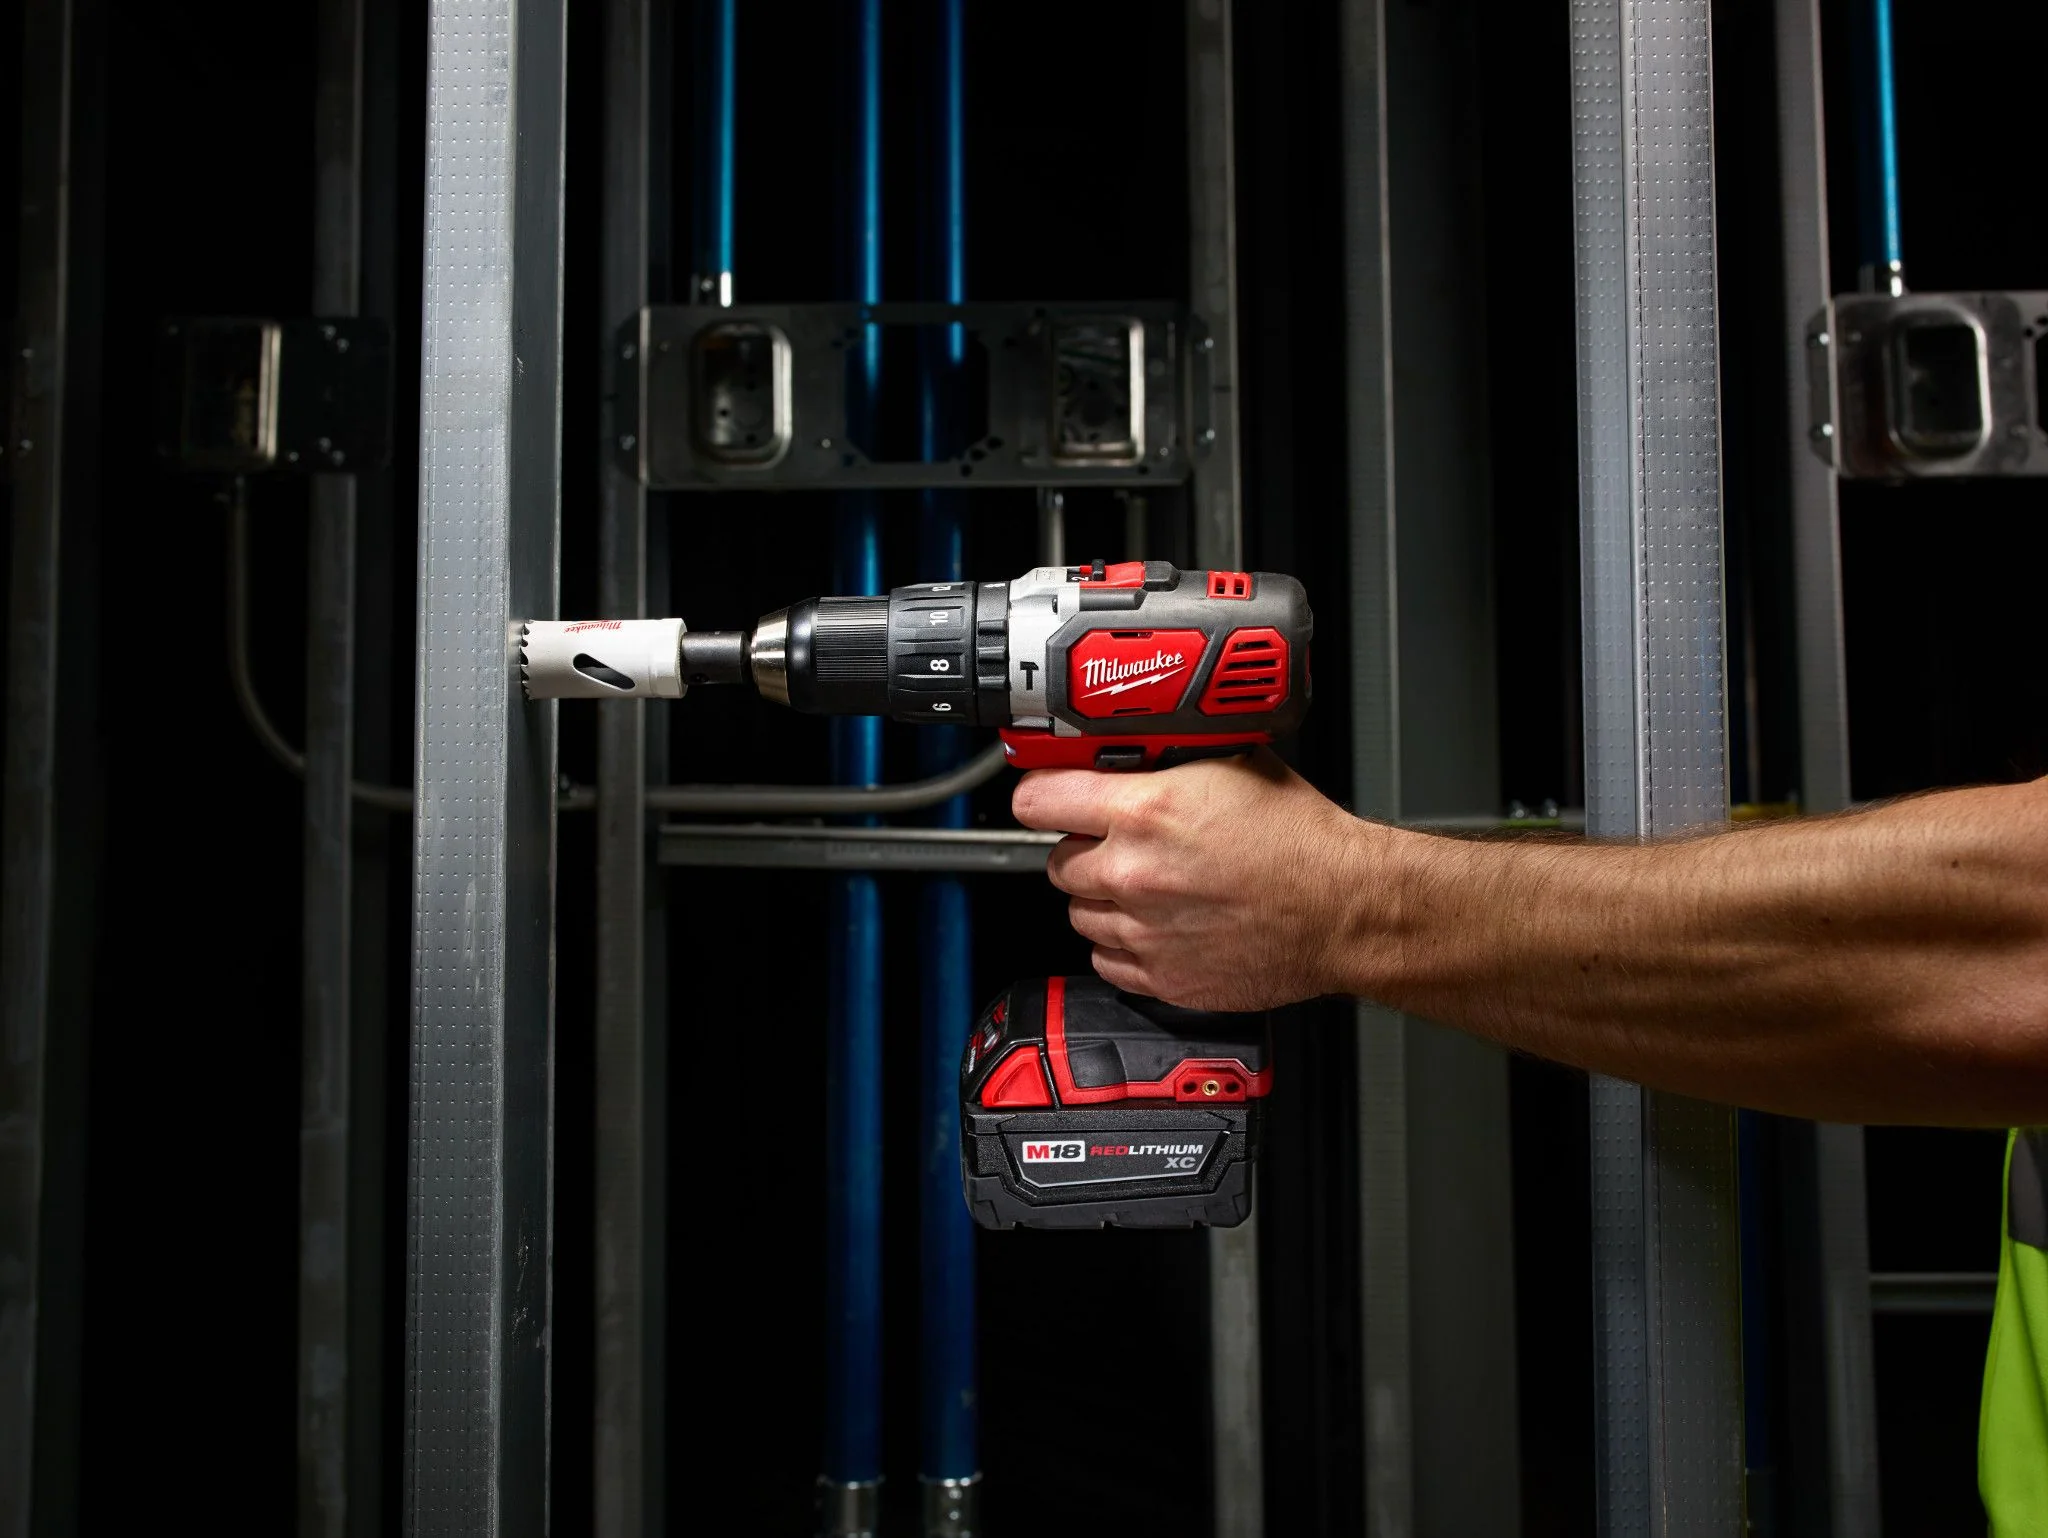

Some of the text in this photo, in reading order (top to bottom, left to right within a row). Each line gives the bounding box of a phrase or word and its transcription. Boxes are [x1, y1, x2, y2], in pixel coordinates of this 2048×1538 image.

[930, 611, 949, 626] 10
[564, 622, 622, 633] Milwaukee
[930, 659, 949, 671] 8
[1079, 650, 1185, 688] Milwaukee
[932, 703, 951, 712] 6
[1027, 1144, 1204, 1159] M18 REDLITHIUM
[1164, 1157, 1196, 1169] XC
